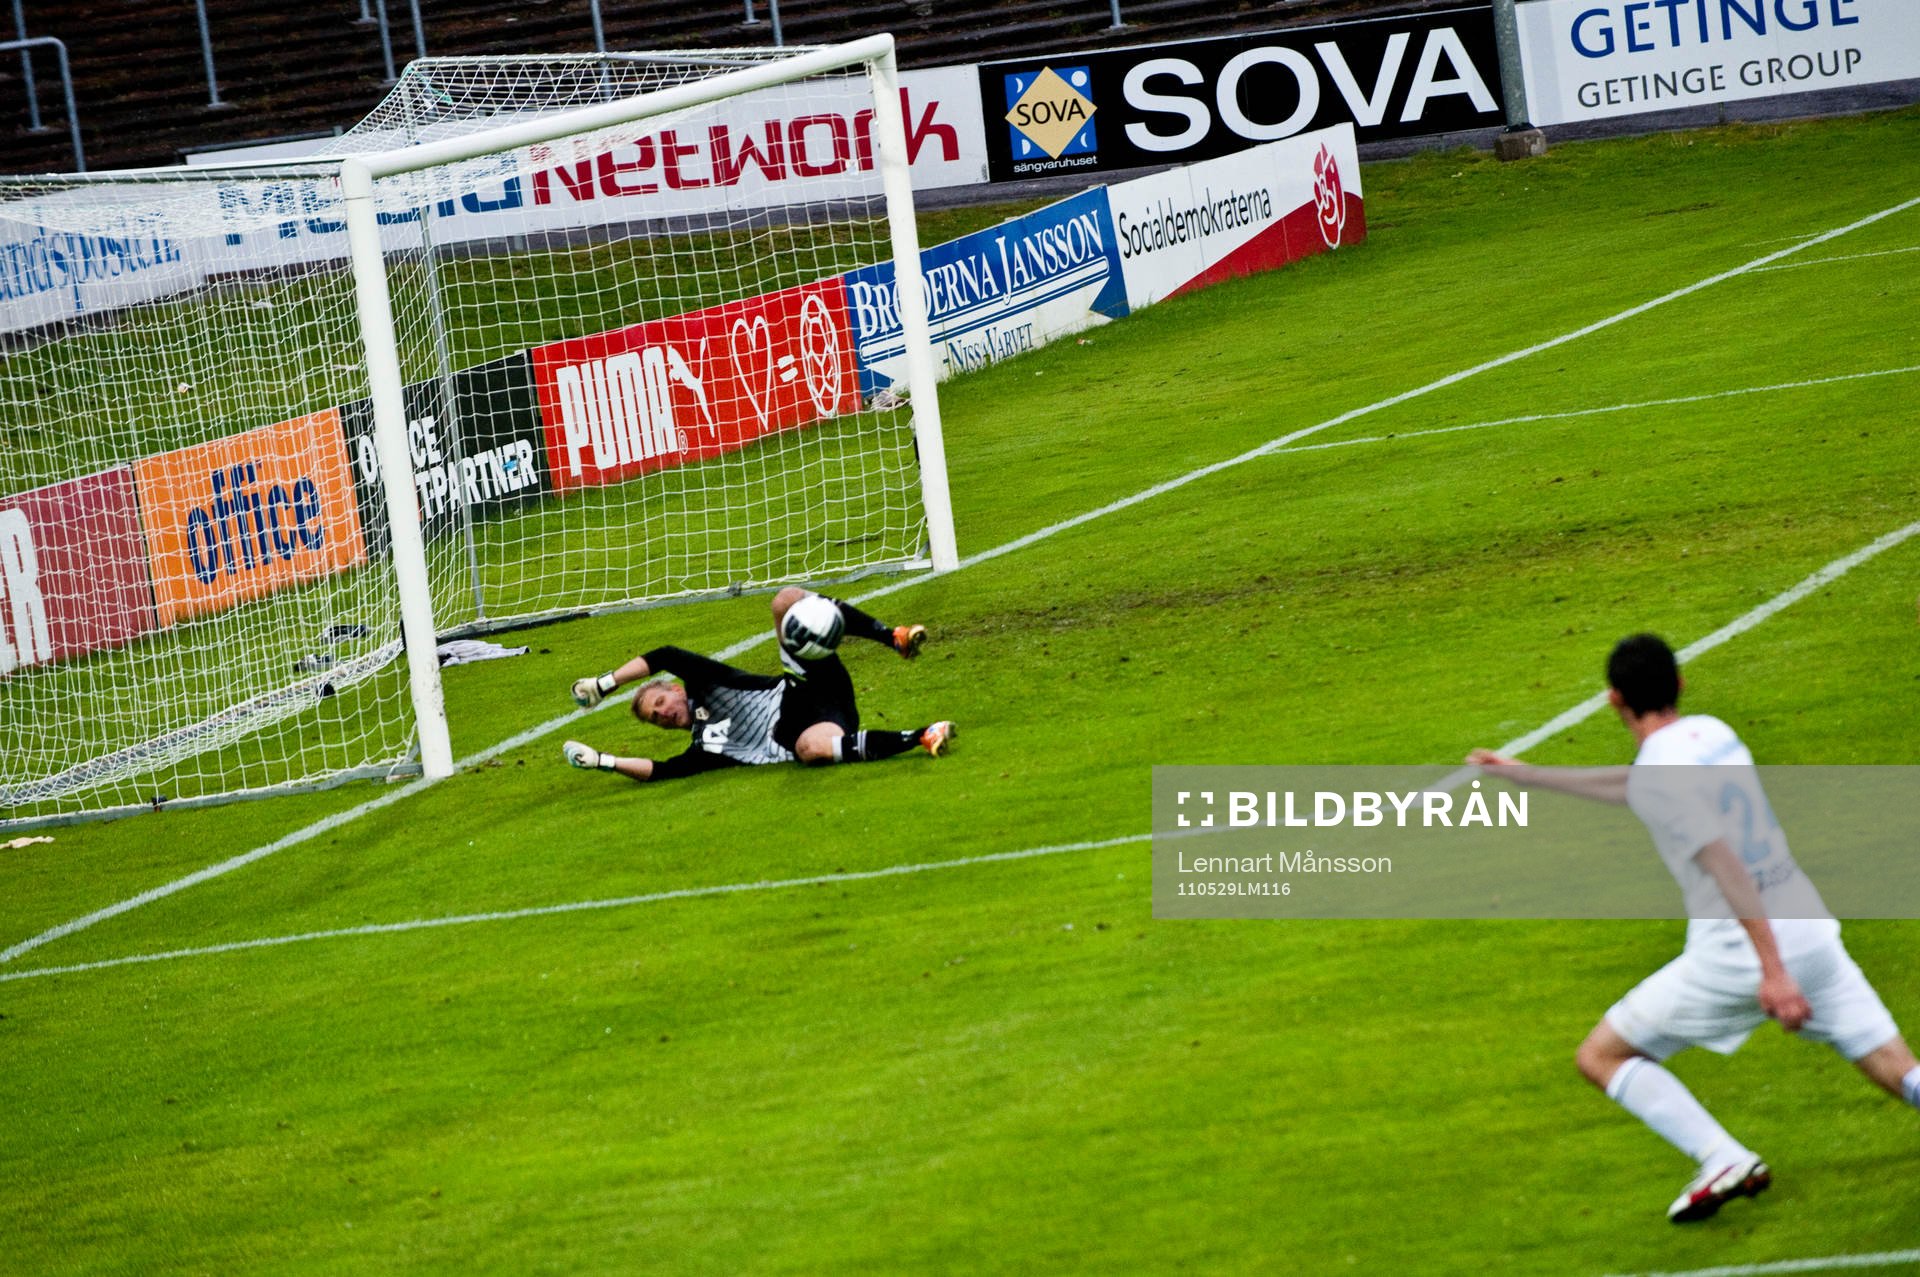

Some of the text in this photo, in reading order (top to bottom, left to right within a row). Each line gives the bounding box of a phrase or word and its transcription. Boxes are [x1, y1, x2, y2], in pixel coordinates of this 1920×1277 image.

[1570, 0, 1859, 58] GETINGE
[1016, 98, 1087, 127] SOVA
[1122, 27, 1499, 152] SOVA
[1578, 48, 1862, 107] GETINGE GROUP
[1013, 155, 1098, 173] sängvaruhuset
[995, 209, 1104, 306] JANSSON
[1119, 187, 1272, 259] Socialdemokraterna
[555, 346, 679, 477] PUMA
[187, 463, 325, 585] office
